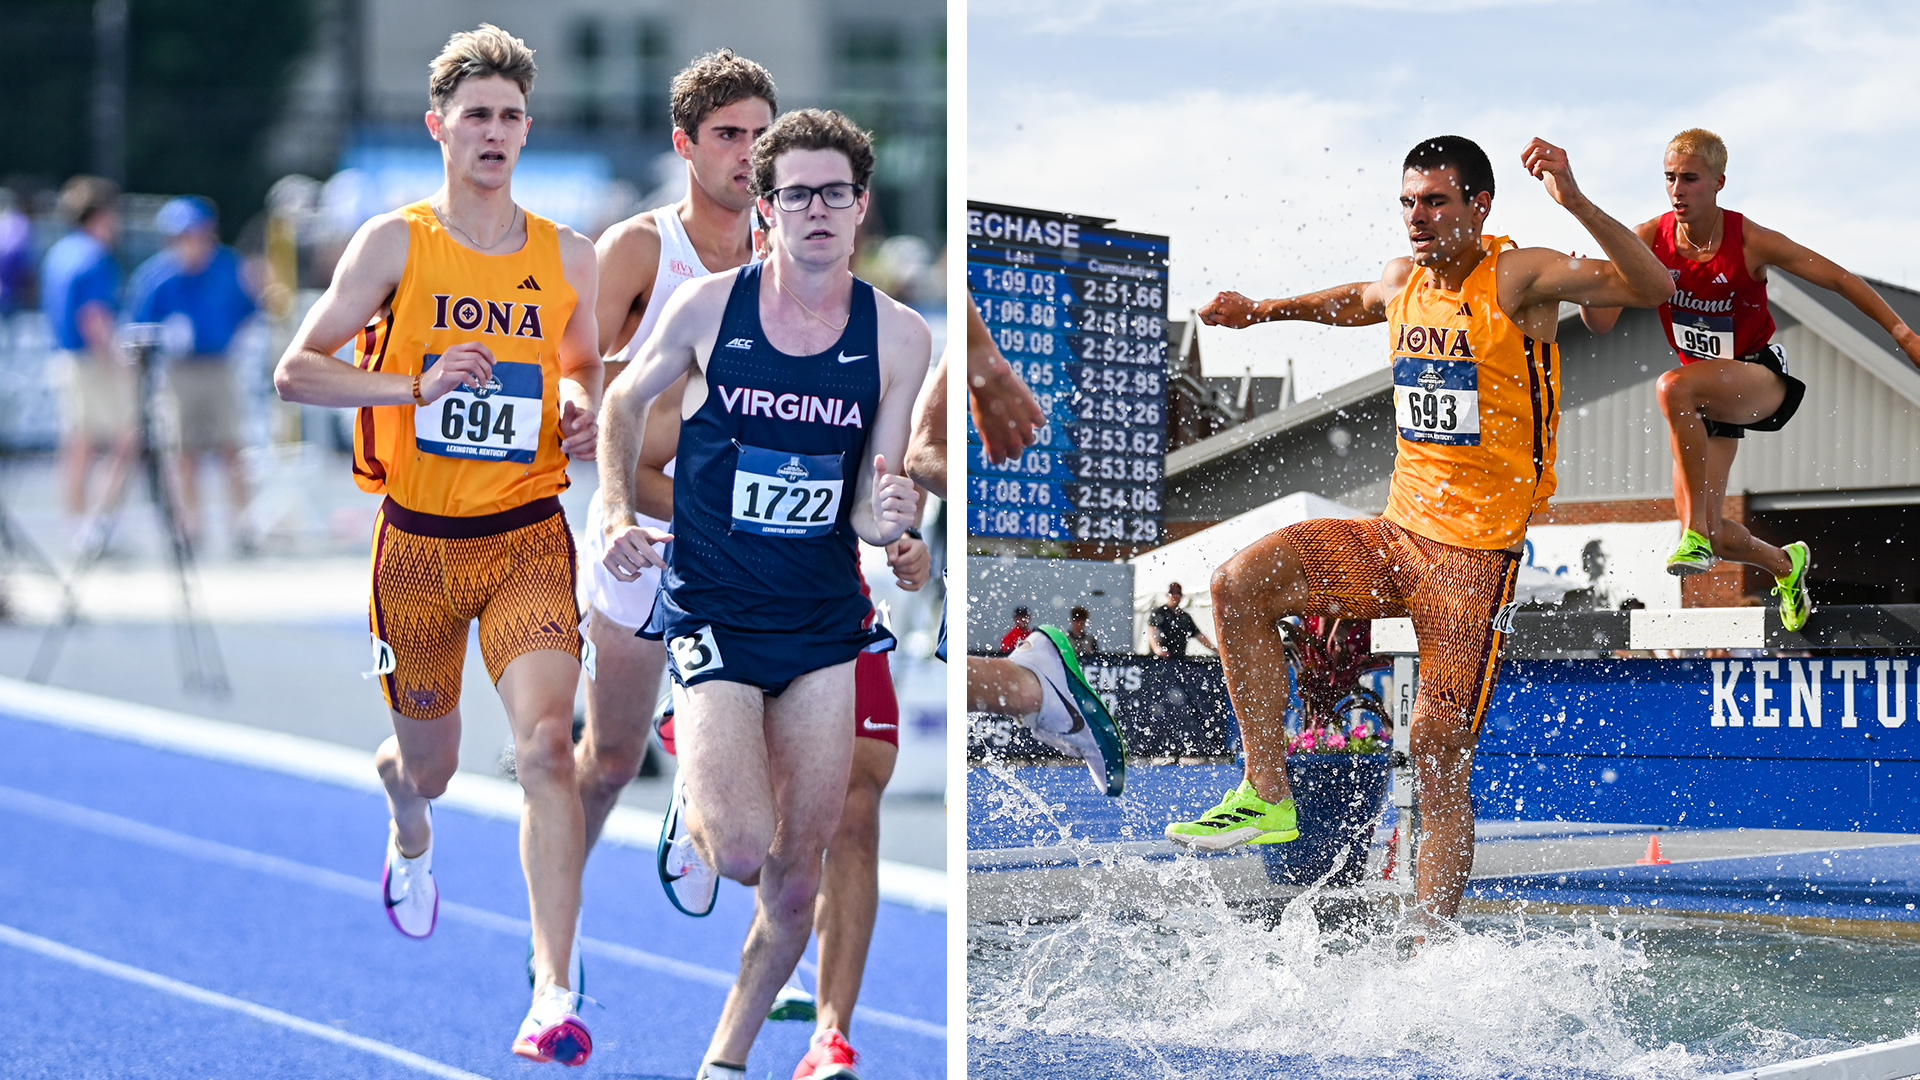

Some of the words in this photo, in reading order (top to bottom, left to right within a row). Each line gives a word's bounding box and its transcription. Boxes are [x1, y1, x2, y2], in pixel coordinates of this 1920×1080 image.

[967, 209, 1080, 249] ECHASE
[1005, 249, 1035, 264] Last
[1088, 259, 1160, 280] Cumulative
[983, 268, 1055, 295] 1:09.03
[1083, 280, 1162, 308] 2:51.66
[982, 298, 1055, 328] 1:06.80
[1668, 289, 1735, 313] Miami
[431, 294, 545, 340] IONA
[1083, 309, 1162, 338] 2:51.86
[726, 338, 754, 349] ACC
[994, 329, 1054, 355] :09.08
[1082, 338, 1162, 364] 2:52.24
[1396, 323, 1476, 359] IONA
[1685, 330, 1720, 356] 950
[1081, 366, 1160, 396] 2:52.95
[717, 384, 863, 429] VIRGINIA
[1081, 397, 1160, 425] 2:53.26
[1408, 392, 1457, 431] 693
[441, 398, 516, 445] 694
[446, 444, 478, 456] LEXINGTON,
[479, 447, 507, 458] KENTUCKY
[1080, 427, 1160, 454] 2:53.62
[1079, 455, 1158, 482] 2:53.85
[743, 482, 834, 522] 1722
[977, 478, 1051, 505] 1:08.76
[1078, 485, 1158, 512] 2:54.06
[976, 509, 1050, 536] 1:08.18
[1078, 515, 1157, 542] 2:54.29
[677, 633, 713, 671] 3
[1084, 665, 1142, 691] EN'S
[1711, 660, 1920, 728] KENTU
